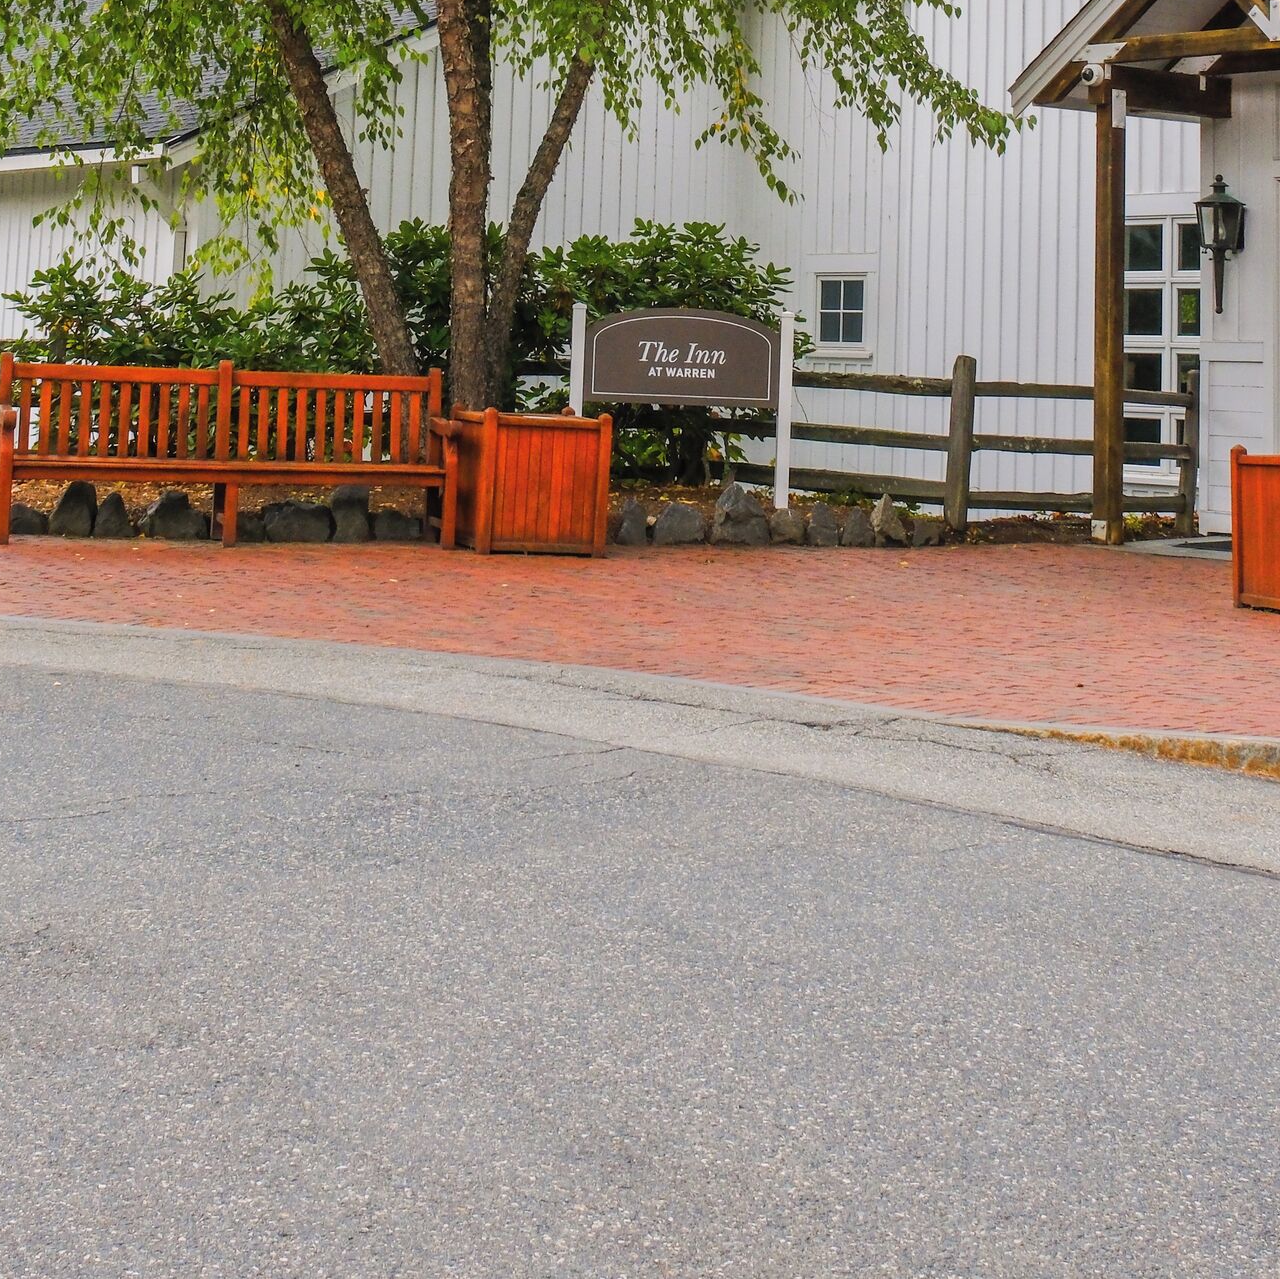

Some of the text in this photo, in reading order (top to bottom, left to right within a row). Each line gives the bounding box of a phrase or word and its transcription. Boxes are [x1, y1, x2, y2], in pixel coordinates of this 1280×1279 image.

[638, 341, 726, 365] The Inn
[648, 367, 715, 378] AT WARREN
